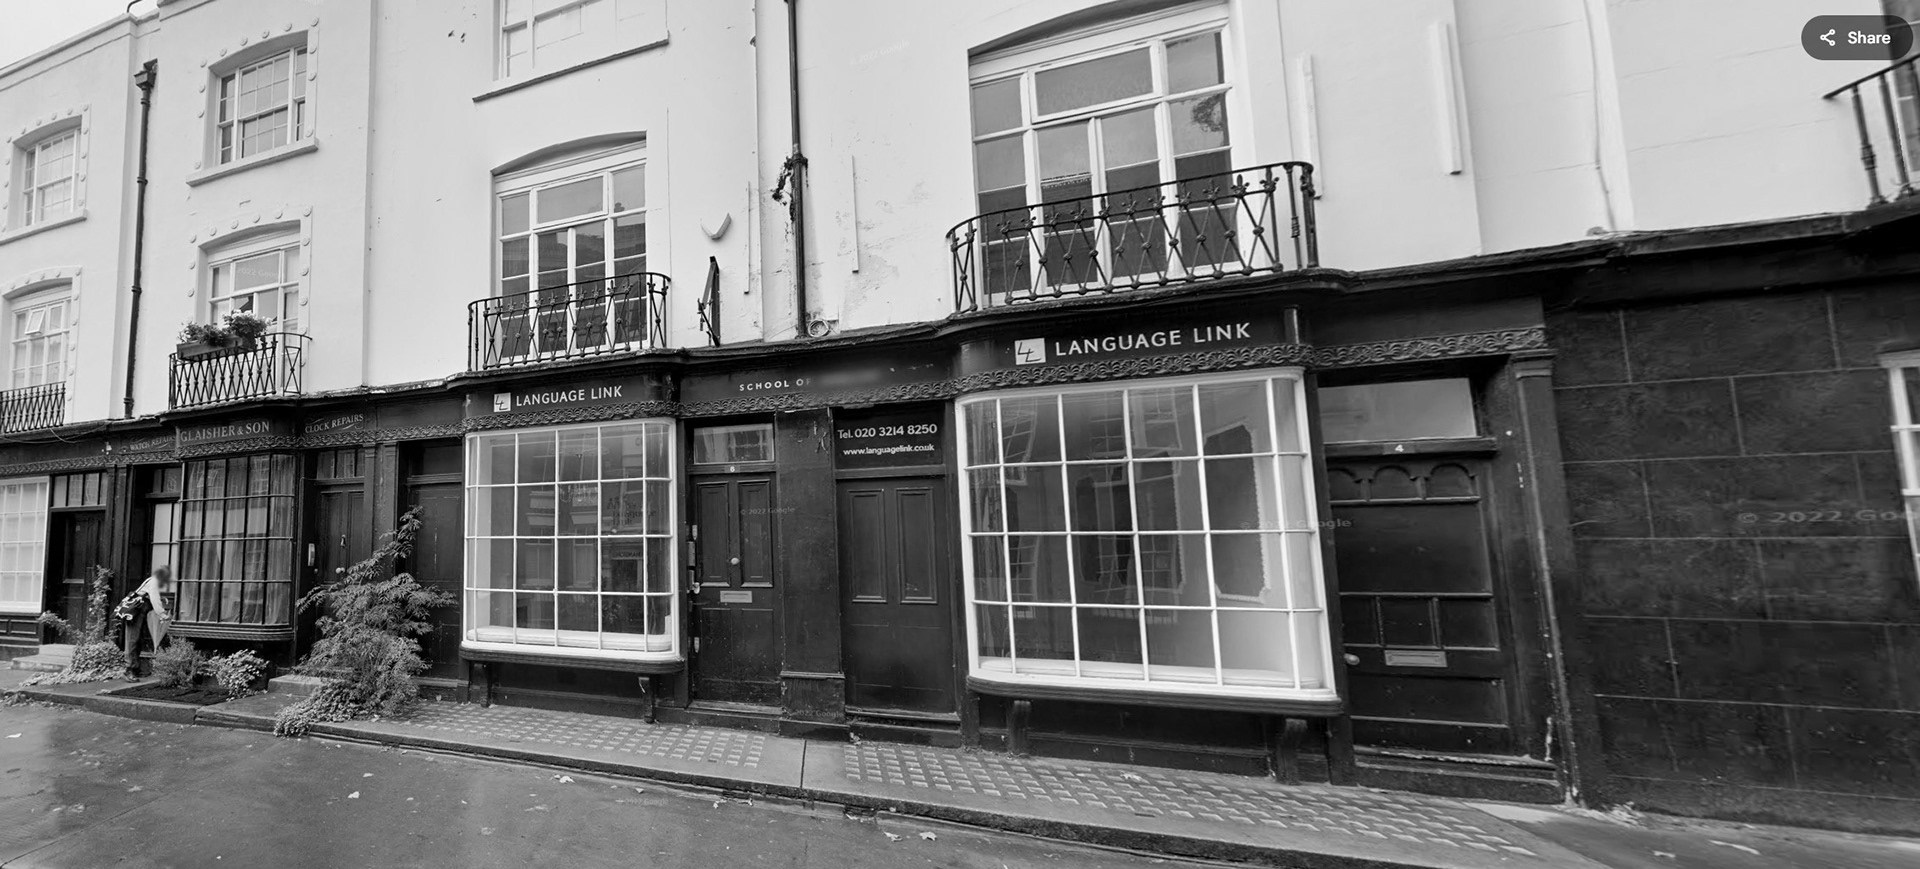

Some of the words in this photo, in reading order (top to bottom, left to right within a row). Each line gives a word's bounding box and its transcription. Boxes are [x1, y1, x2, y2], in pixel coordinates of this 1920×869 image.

[1055, 330, 1182, 356] LANGUAGE
[1193, 322, 1251, 344] LINK
[739, 379, 790, 392] SCHOOL
[516, 390, 585, 407] LANGUAGE
[591, 385, 622, 400] LINK
[180, 425, 235, 442] GLAISHER
[237, 426, 244, 436] &
[246, 420, 270, 434] SON
[304, 422, 330, 434] CLOCK
[331, 414, 364, 429] REPAIRS
[838, 429, 854, 439] Tel.
[854, 427, 876, 438] 020
[878, 425, 905, 437] 3214
[907, 423, 938, 435] 8250
[843, 443, 935, 456] www.languagelink.co.uk
[1394, 444, 1404, 453] 4
